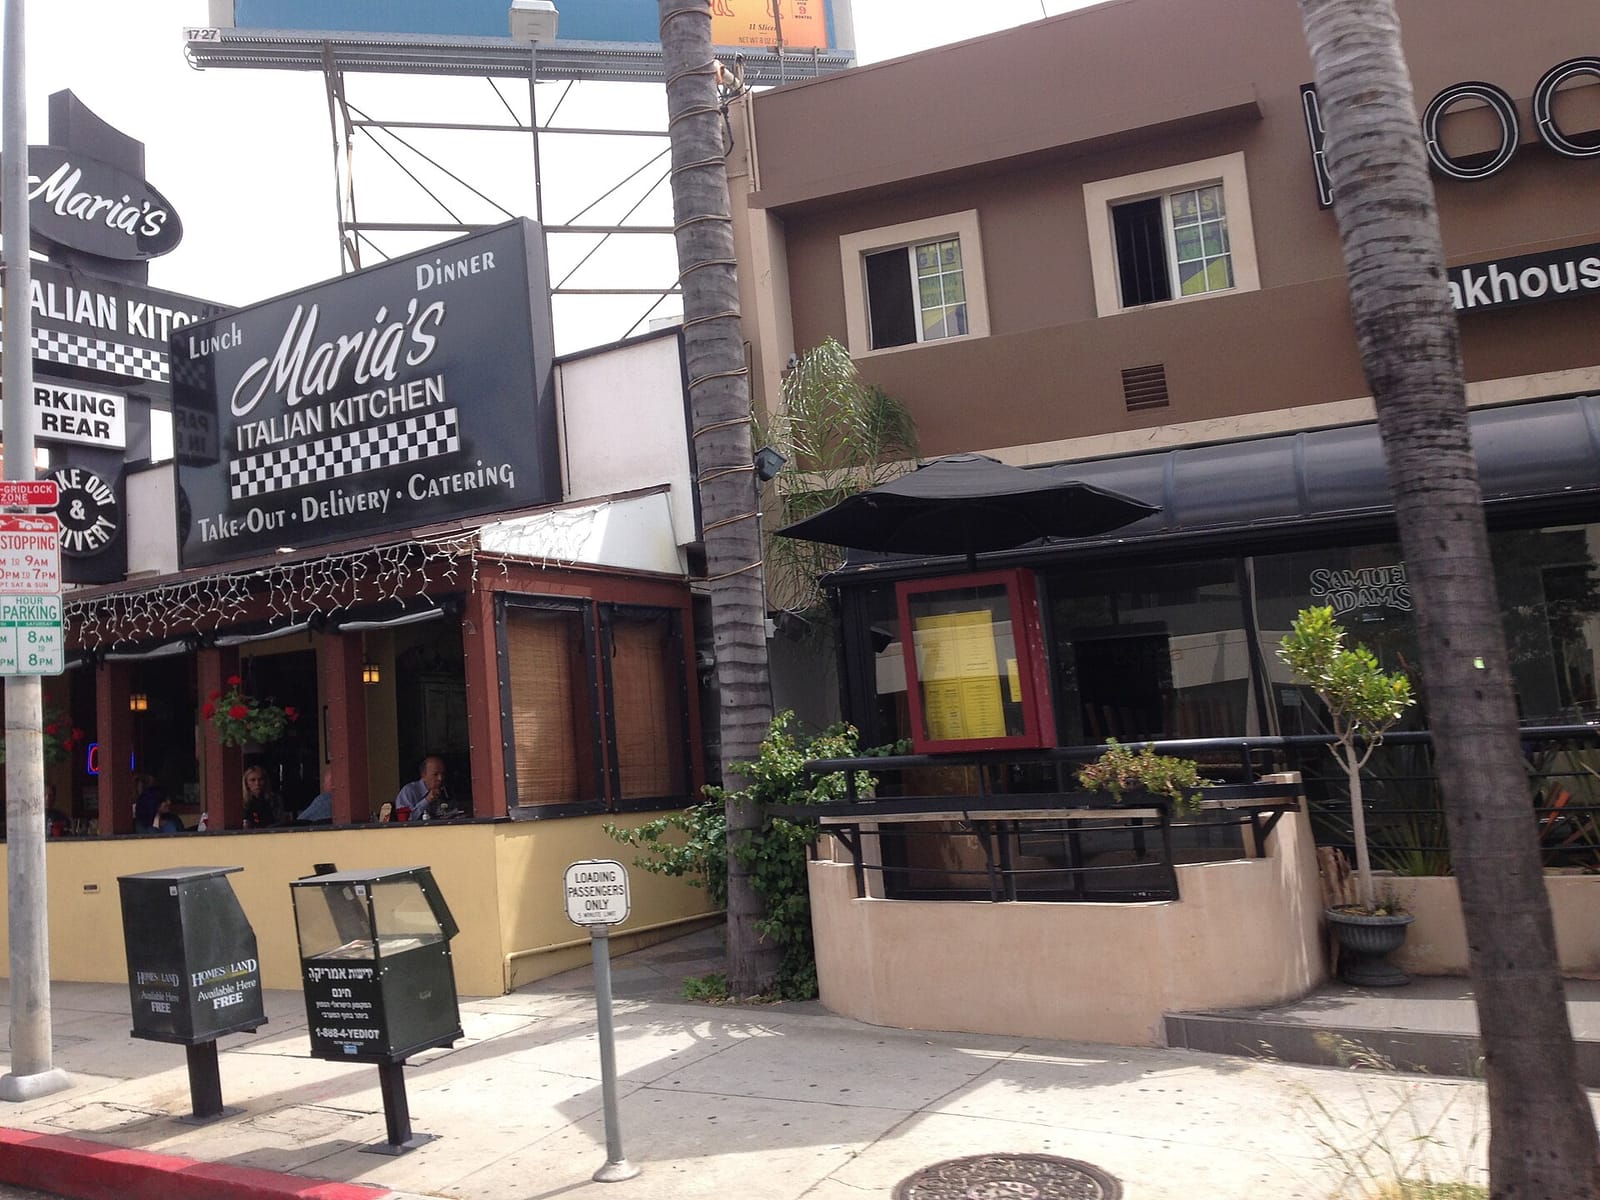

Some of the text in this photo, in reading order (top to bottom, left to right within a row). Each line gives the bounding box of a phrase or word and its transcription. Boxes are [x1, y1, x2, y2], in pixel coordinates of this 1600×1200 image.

[28, 162, 167, 236] Maria's
[1447, 257, 1600, 309] akhous
[31, 278, 117, 331] ALIAN
[230, 298, 446, 417] Maria's
[34, 387, 116, 418] RKING
[236, 374, 446, 452] ITALIAN KITCHEN
[42, 412, 110, 440] REAR
[0, 493, 28, 501] ZONE
[55, 469, 116, 506] KE OUT
[70, 499, 85, 520] &
[1, 535, 55, 551] STOPPING
[59, 515, 116, 551] LIVERY
[16, 597, 43, 605] HOUR
[3, 605, 57, 620] PARKING
[575, 871, 616, 883] LOADING
[568, 885, 624, 897] PASSENGERS
[585, 899, 609, 910] ONLY
[198, 979, 256, 1001] Available Here
[213, 992, 244, 1009] FREE
[332, 988, 352, 998] חינם
[151, 1002, 171, 1013] FREE
